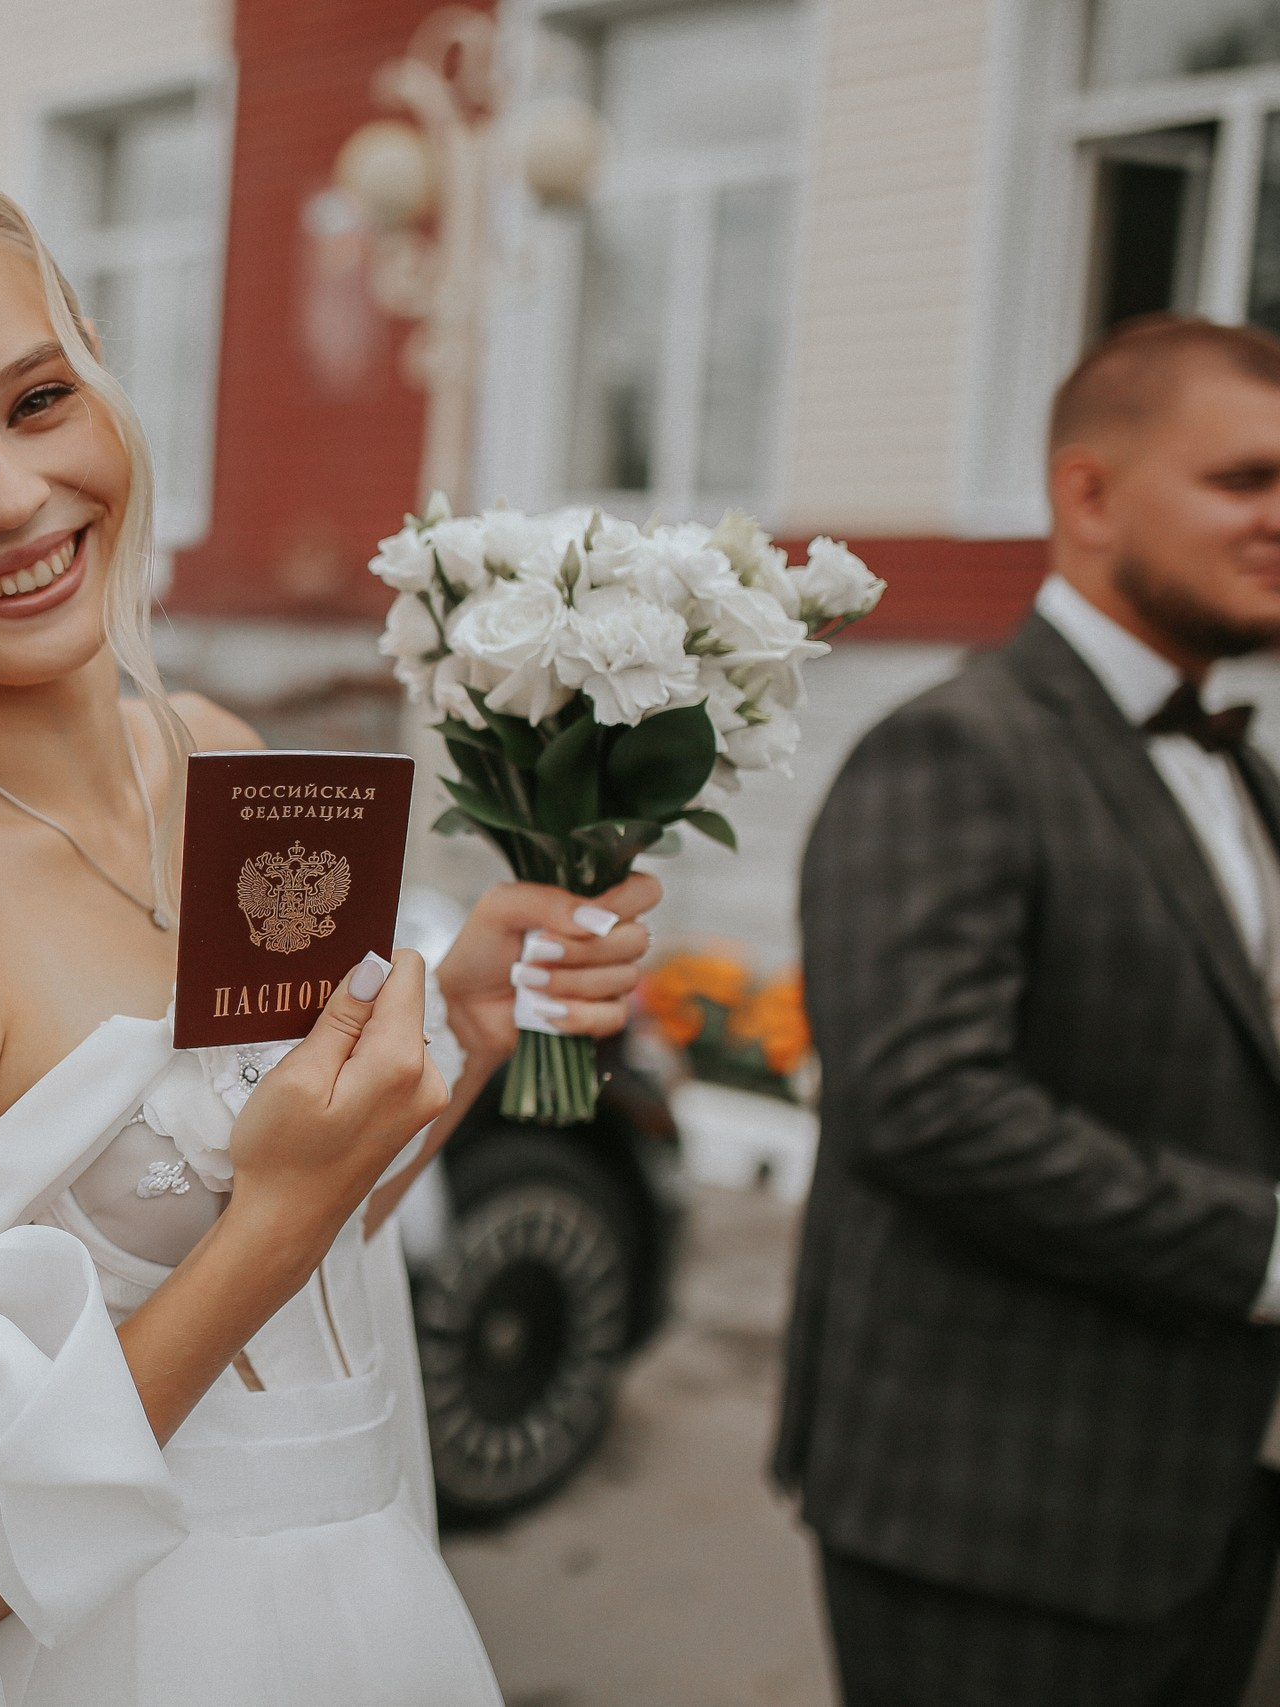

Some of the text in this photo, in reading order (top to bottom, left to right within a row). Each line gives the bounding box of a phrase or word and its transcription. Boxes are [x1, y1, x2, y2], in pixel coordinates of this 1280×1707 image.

[231, 783, 377, 800] РОССИЙСКАЯ
[239, 805, 365, 822] ФЕДЕРАЦИЯ
[213, 979, 344, 1018] ПАСПОР
